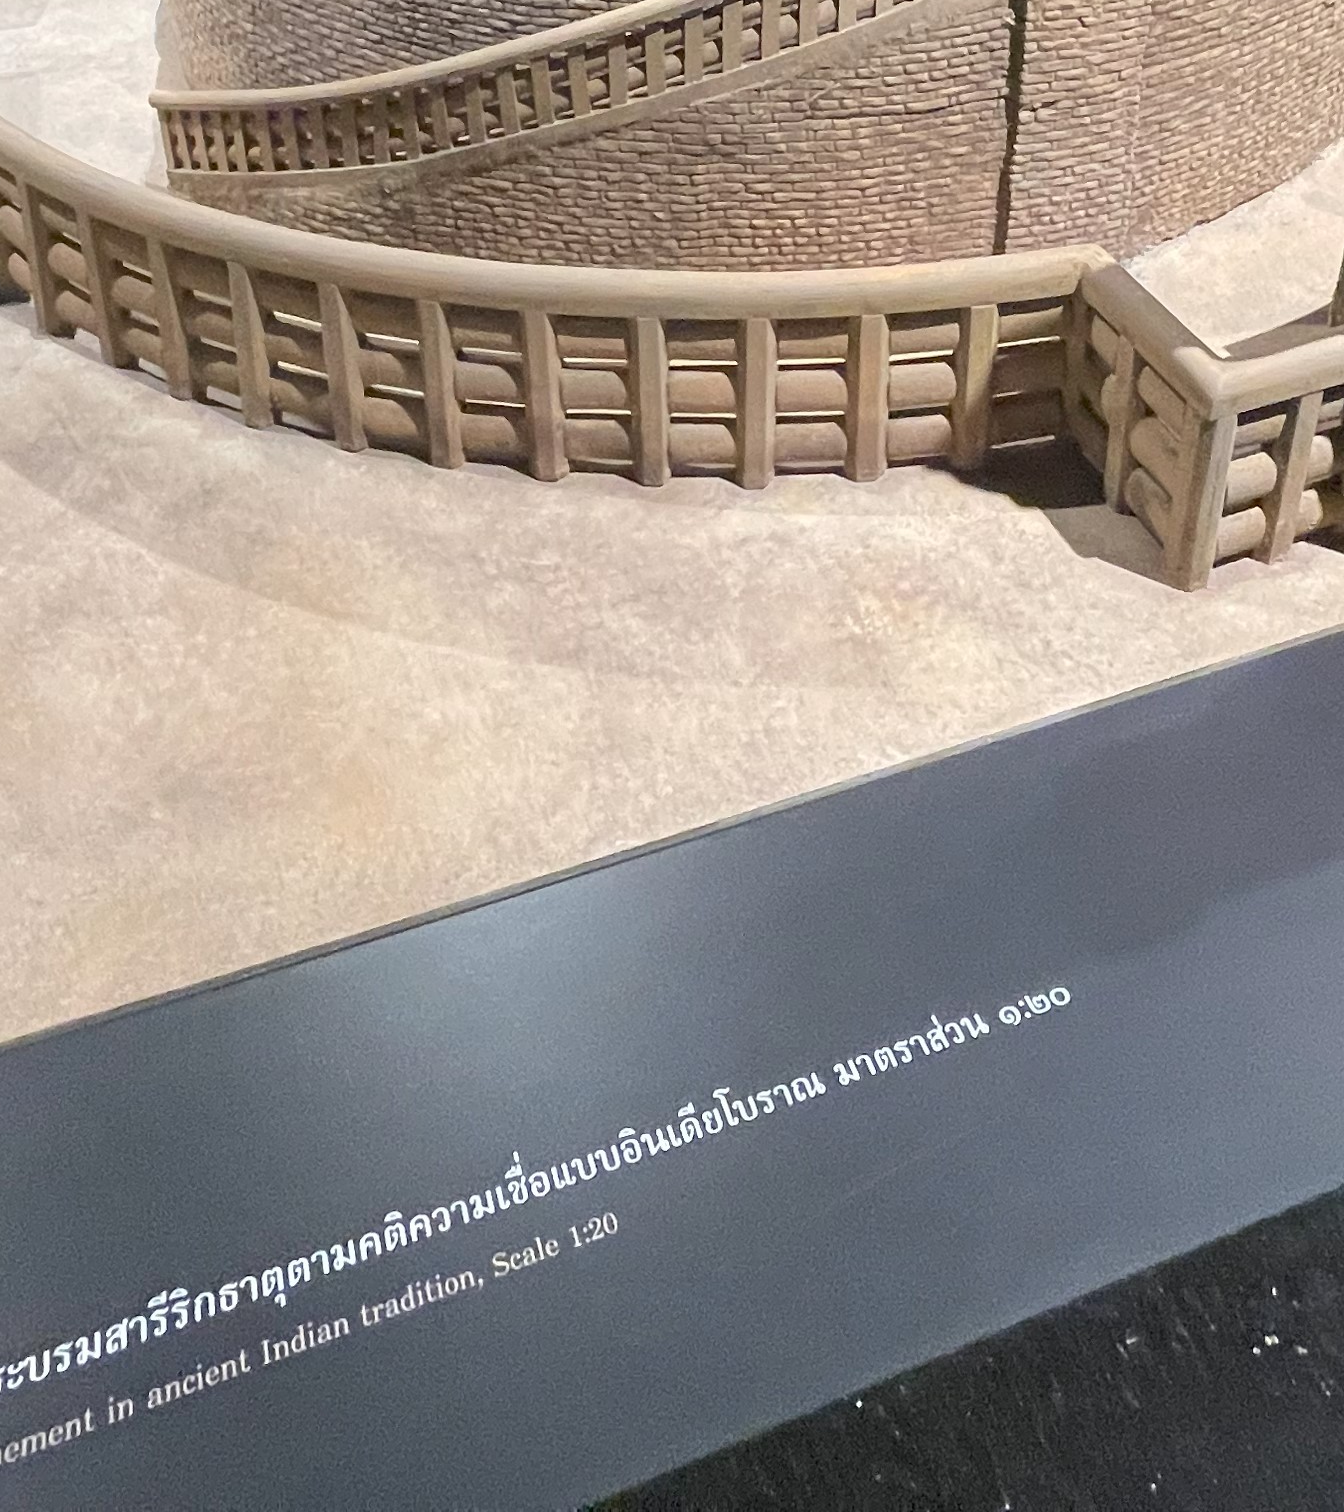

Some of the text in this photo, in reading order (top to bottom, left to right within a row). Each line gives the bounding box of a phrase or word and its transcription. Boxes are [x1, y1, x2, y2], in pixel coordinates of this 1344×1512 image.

[832, 1014, 990, 1087] มาตราส่วน
[998, 986, 1072, 1027] ๑:๒๐
[107, 1394, 134, 1426] in
[146, 1347, 252, 1409] ancient
[261, 1314, 351, 1366] Indian
[360, 1267, 485, 1328] tradition,
[492, 1237, 561, 1279] Scale
[569, 1210, 619, 1249] 1:20
